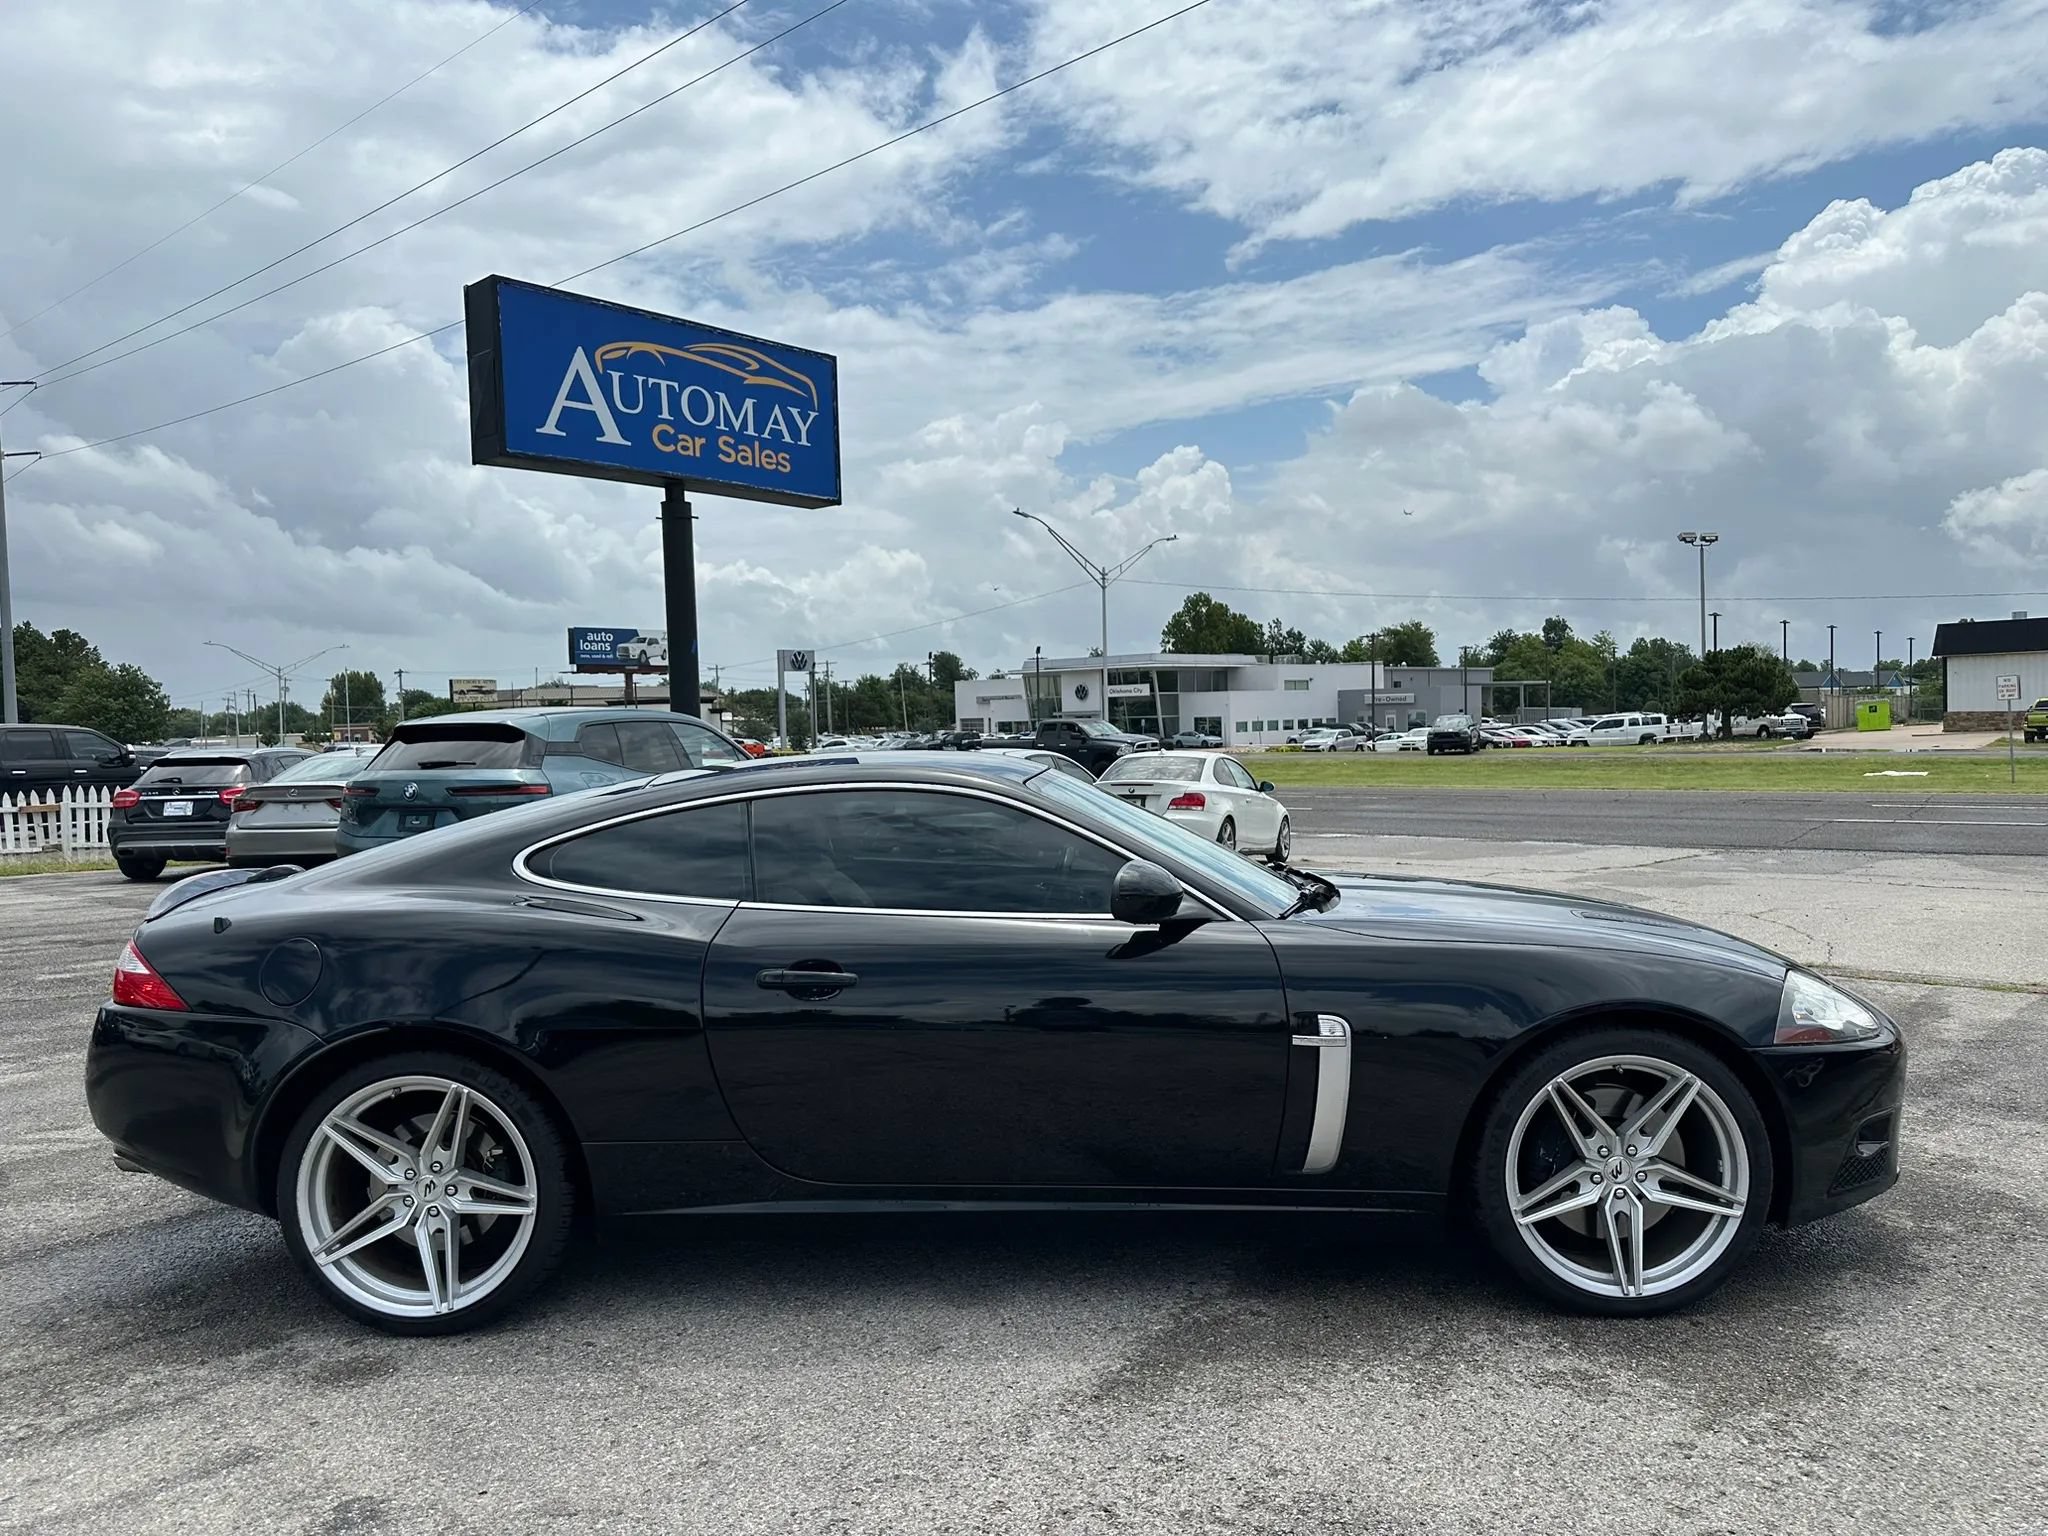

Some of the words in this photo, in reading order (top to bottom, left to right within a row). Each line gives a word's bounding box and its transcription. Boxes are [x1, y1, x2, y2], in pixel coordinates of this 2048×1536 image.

[535, 345, 819, 447] AUTOMAY
[651, 423, 706, 458] Car
[717, 435, 792, 473] Sales
[580, 640, 611, 651] loans
[586, 632, 614, 641] auto
